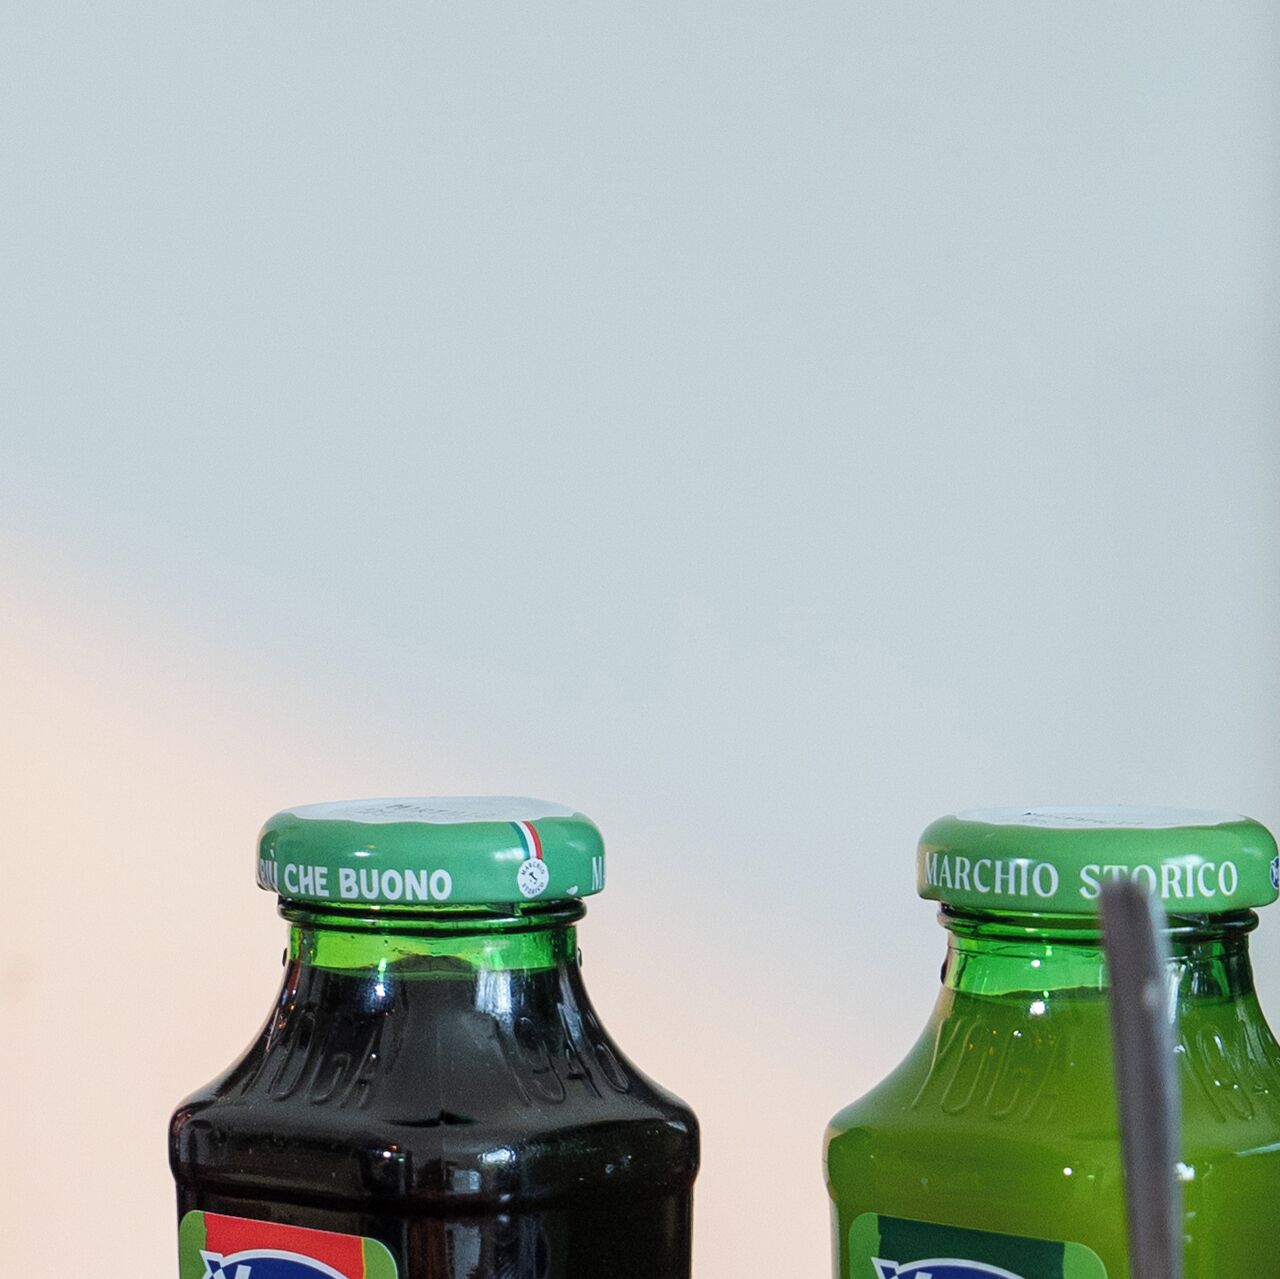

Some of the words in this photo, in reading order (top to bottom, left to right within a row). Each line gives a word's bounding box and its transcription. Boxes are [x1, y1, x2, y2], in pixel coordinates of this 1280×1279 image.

[284, 863, 329, 897] CHE
[339, 867, 453, 900] BUONO
[924, 851, 1060, 898] MARCHIO
[1079, 860, 1238, 899] STORICO
